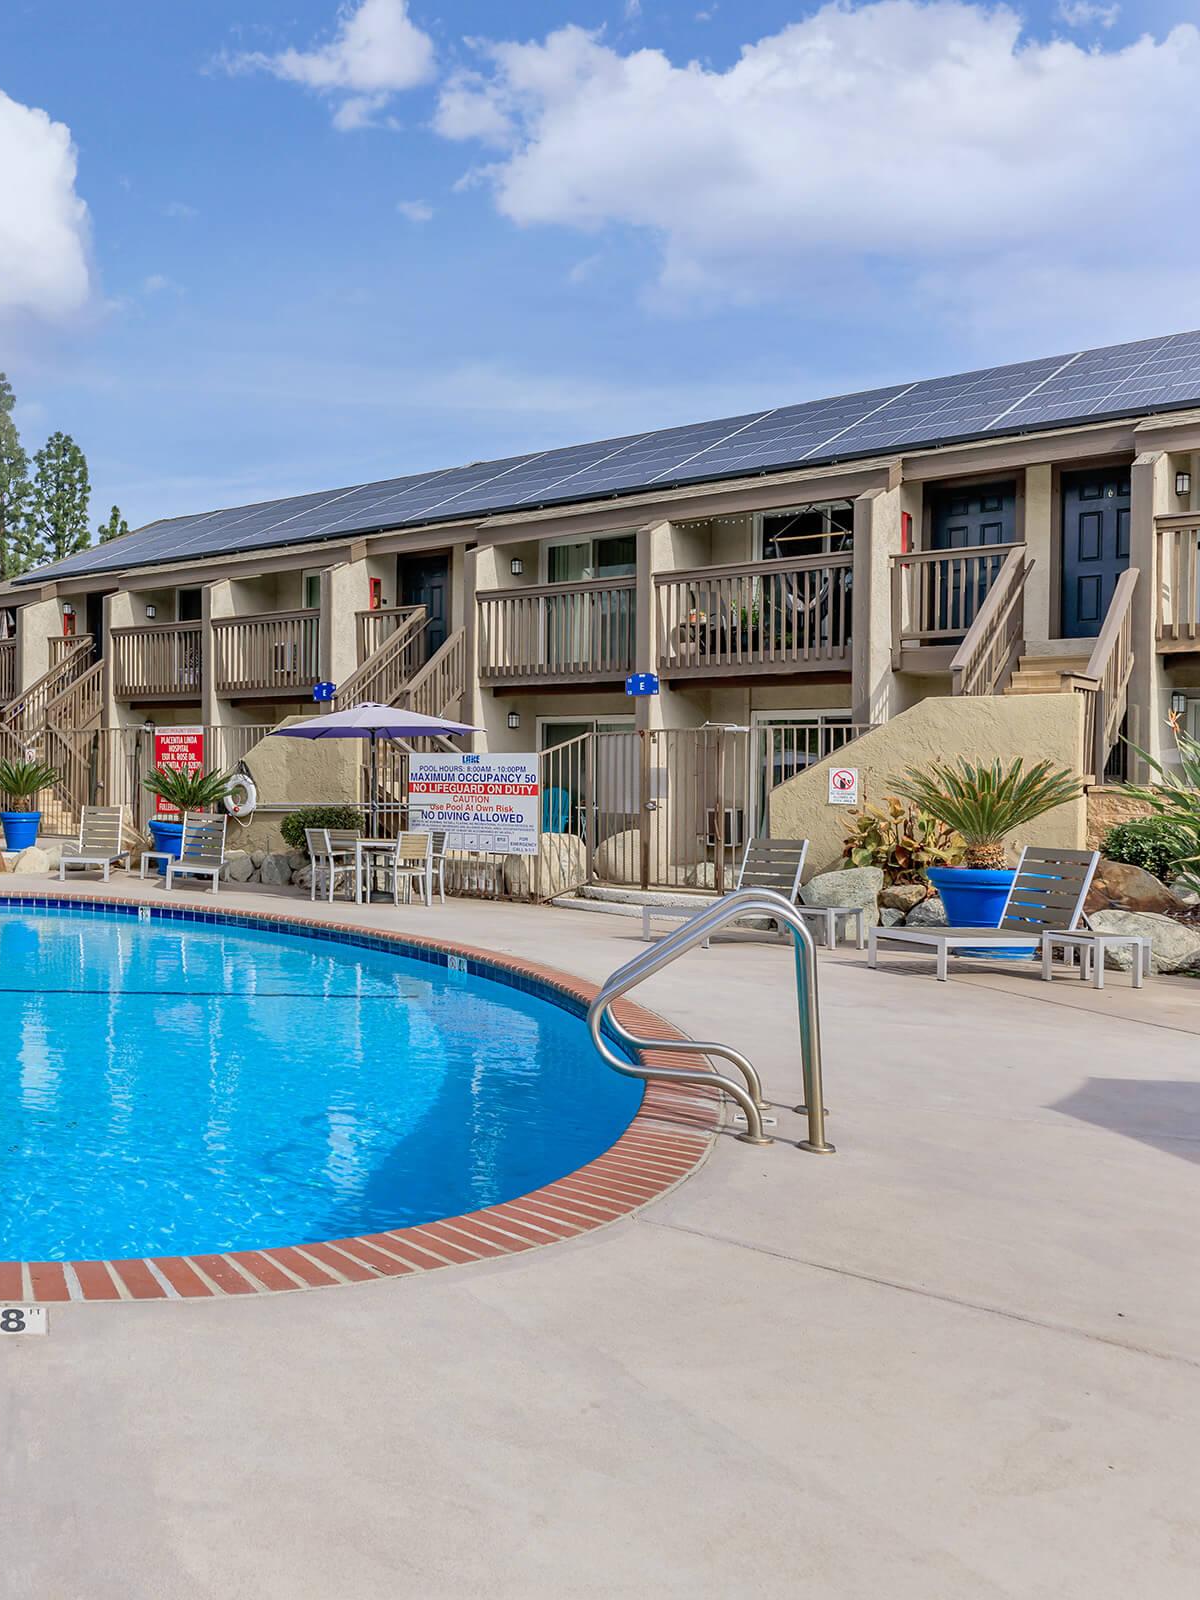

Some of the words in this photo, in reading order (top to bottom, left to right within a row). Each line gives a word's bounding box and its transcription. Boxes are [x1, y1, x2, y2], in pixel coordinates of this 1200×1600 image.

[640, 682, 645, 690] E
[160, 736, 183, 744] PLACENTIA
[410, 773, 455, 782] MAXIMUM
[458, 773, 522, 783] OCCUPANCY
[525, 774, 536, 783] 50
[413, 783, 426, 792] NO
[429, 784, 485, 793] LIFEGUARD
[487, 785, 502, 794] ON
[504, 785, 533, 794] DUTY
[421, 811, 434, 820] NO
[438, 811, 470, 821] DIVING
[473, 813, 524, 823] ALLOWED
[0, 1309, 26, 1332] 8
